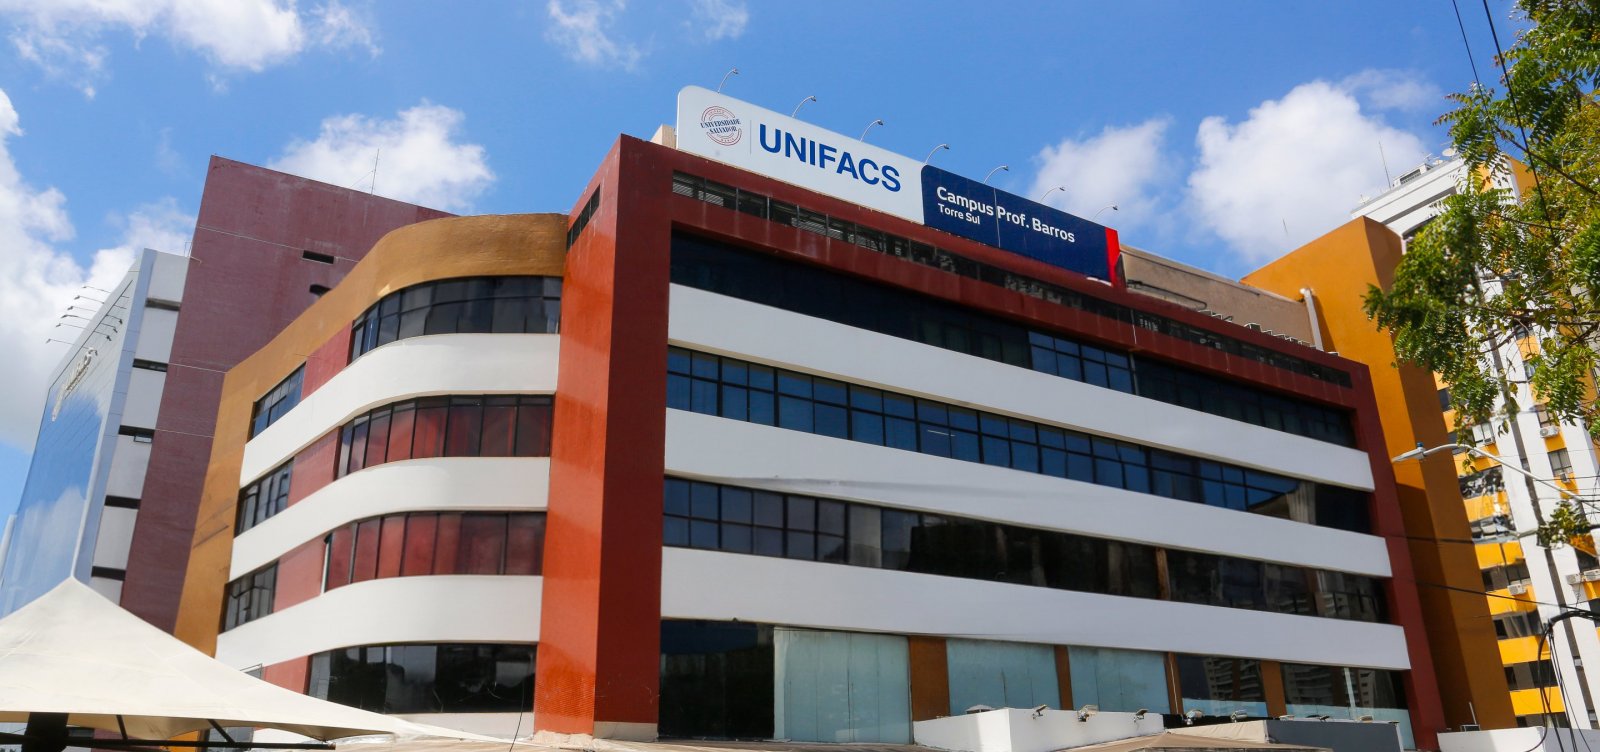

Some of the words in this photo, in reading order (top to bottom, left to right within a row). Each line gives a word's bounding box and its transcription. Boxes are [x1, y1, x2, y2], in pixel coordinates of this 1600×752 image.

[760, 123, 901, 192] UNIFACS
[936, 186, 994, 216] Campus
[997, 206, 1030, 229] Prof.
[1032, 217, 1076, 243] Barros
[938, 203, 964, 219] Torre
[965, 212, 981, 225] Sul
